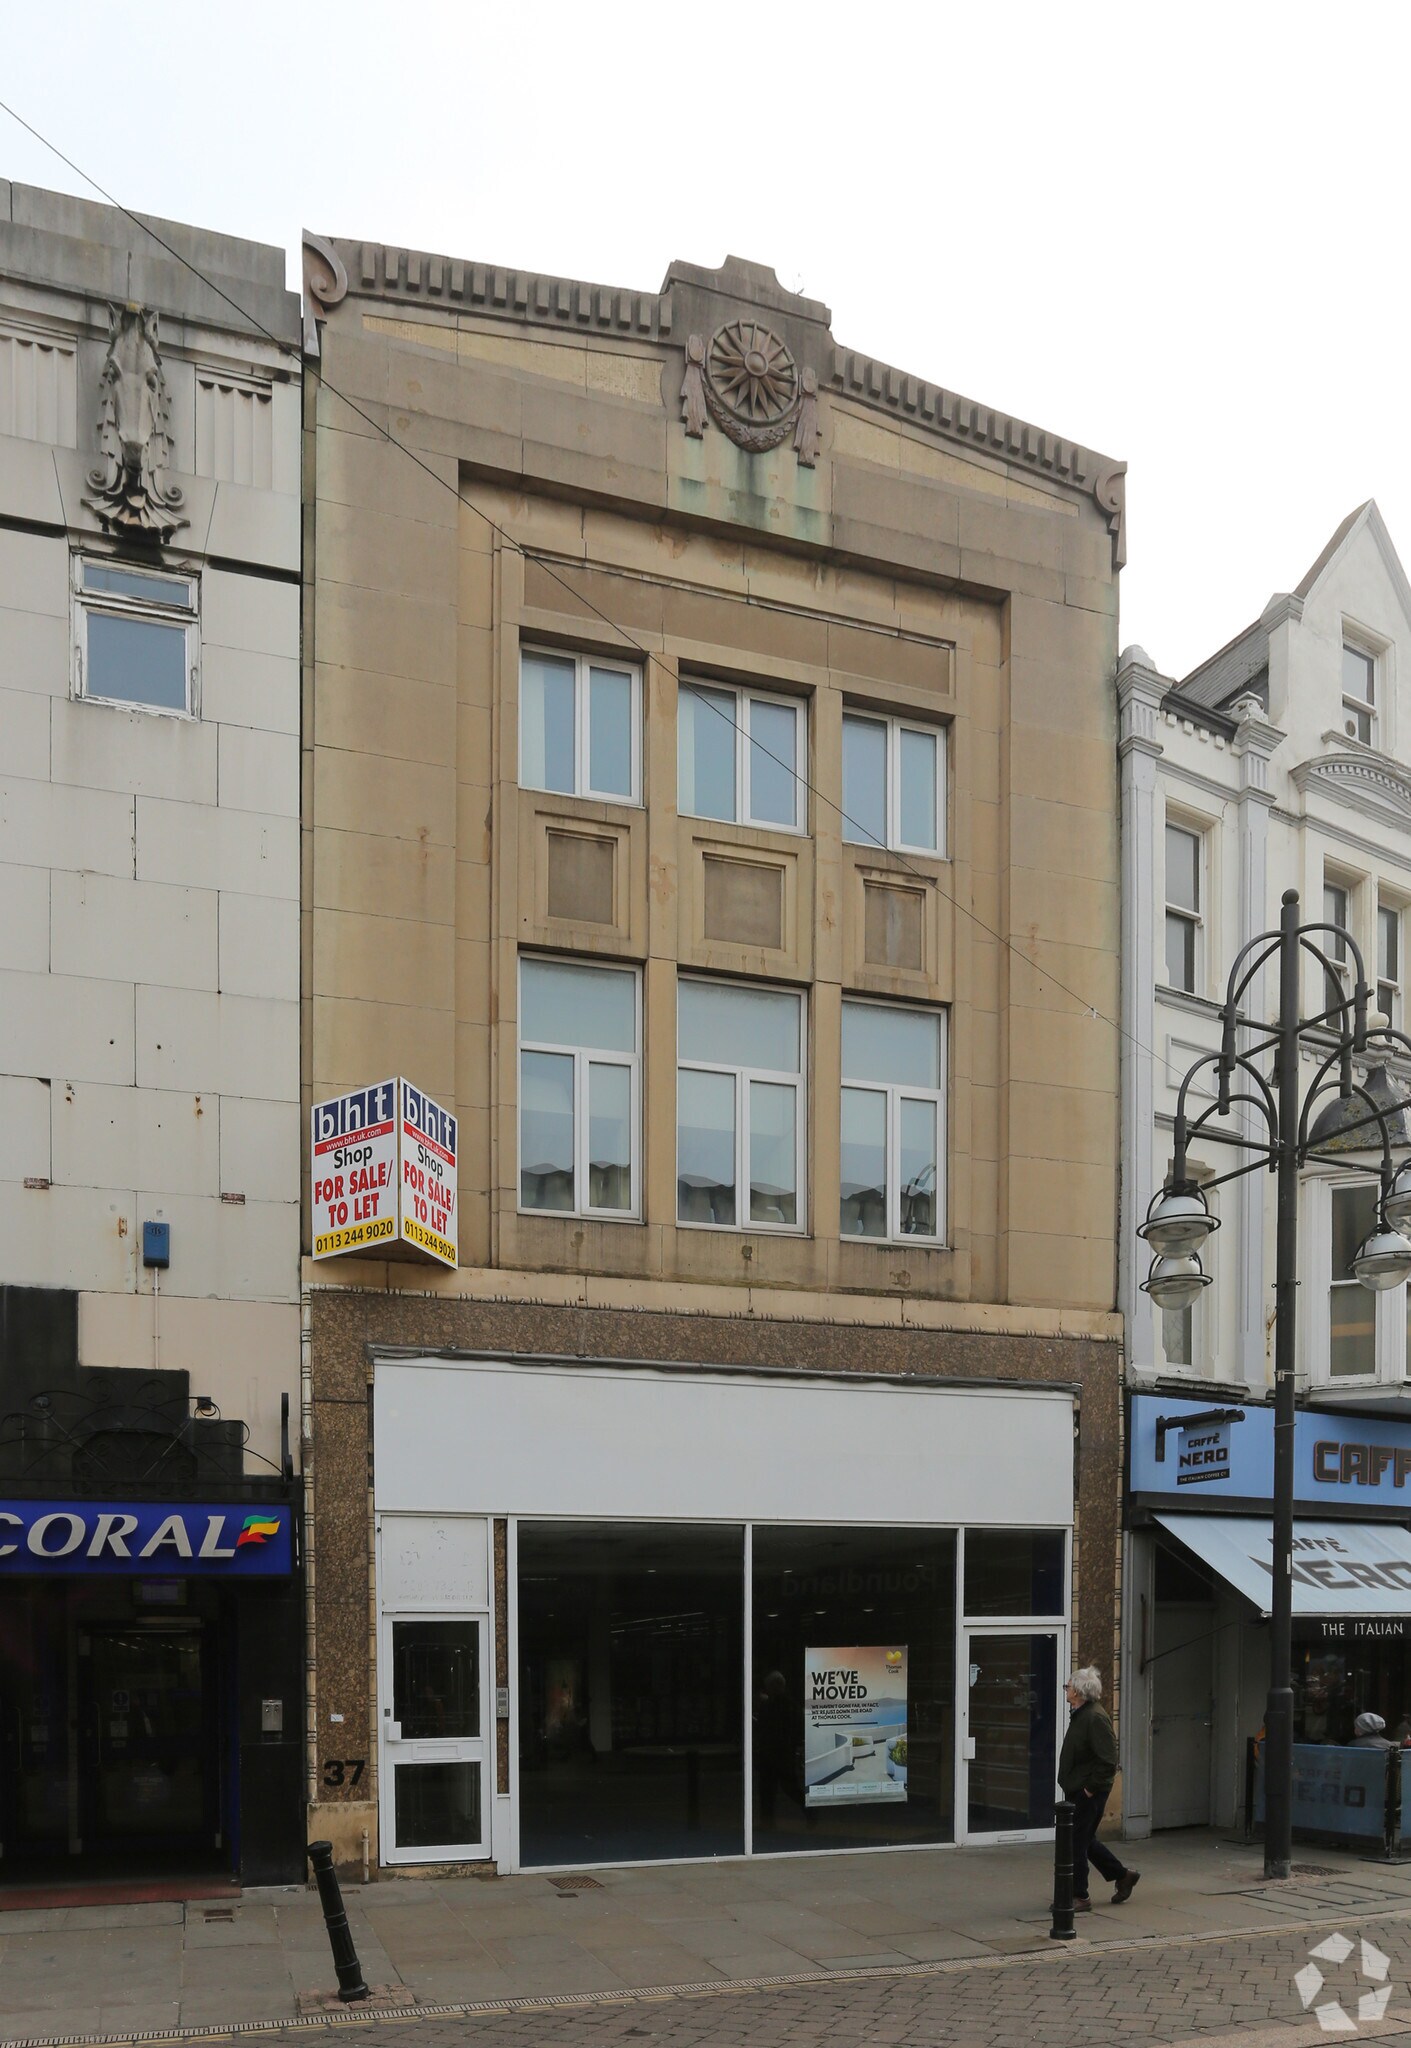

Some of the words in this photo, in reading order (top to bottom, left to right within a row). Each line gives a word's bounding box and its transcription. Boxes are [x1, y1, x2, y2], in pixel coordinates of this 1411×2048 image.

[319, 1087, 386, 1141] bht
[407, 1086, 452, 1151] bht
[326, 1128, 381, 1150] www.bht.uk.com
[334, 1146, 373, 1169] Shop
[418, 1143, 443, 1180] Shop
[315, 1175, 344, 1205] FOR
[349, 1159, 393, 1195] SALE/
[404, 1160, 425, 1195] FOR
[428, 1177, 455, 1215] SALE/
[329, 1202, 348, 1228] TO
[354, 1192, 379, 1221] LET
[414, 1194, 427, 1223] TO
[431, 1206, 447, 1235] LET
[316, 1233, 341, 1252] 0113
[344, 1228, 363, 1245] 244
[366, 1220, 393, 1239] 9020
[405, 1221, 423, 1242] 0113
[425, 1232, 438, 1250] 244
[439, 1241, 455, 1260] 9020
[1188, 1432, 1220, 1448] CAFFÈ
[1180, 1447, 1228, 1468] NERO
[1267, 1537, 1349, 1553] AFFÈ
[1321, 1623, 1345, 1636] THE
[1354, 1622, 1404, 1636] ITALIAN
[811, 1671, 859, 1686] WE'VE
[812, 1685, 867, 1701] MOVED
[323, 1760, 366, 1786] 37
[1292, 1780, 1366, 1808] ERO
